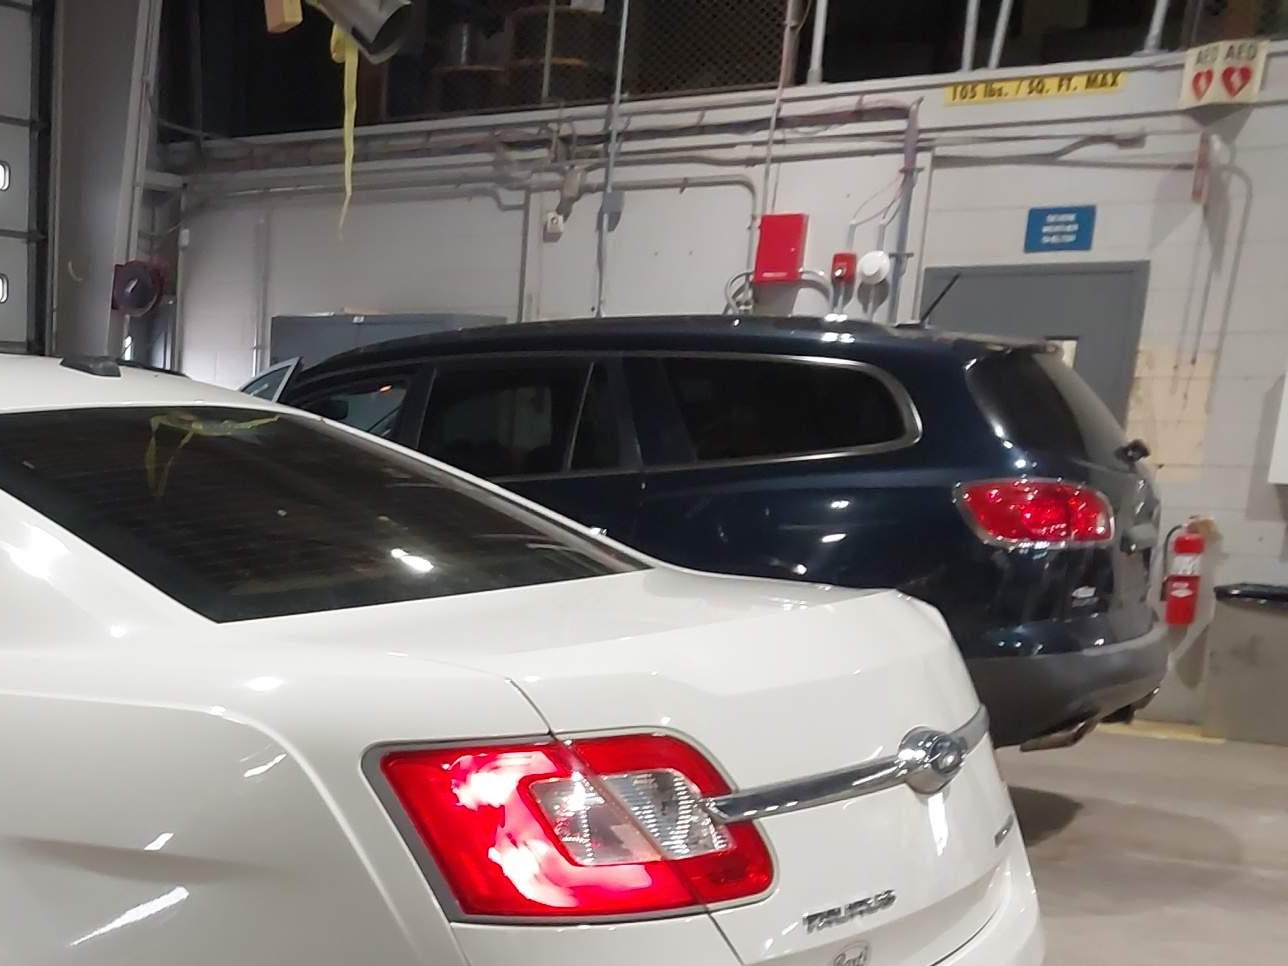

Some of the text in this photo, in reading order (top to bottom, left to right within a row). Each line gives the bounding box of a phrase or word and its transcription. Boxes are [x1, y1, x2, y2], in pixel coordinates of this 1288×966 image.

[951, 84, 976, 101] 105
[1056, 74, 1078, 92] FT.
[1085, 71, 1121, 90] MAX
